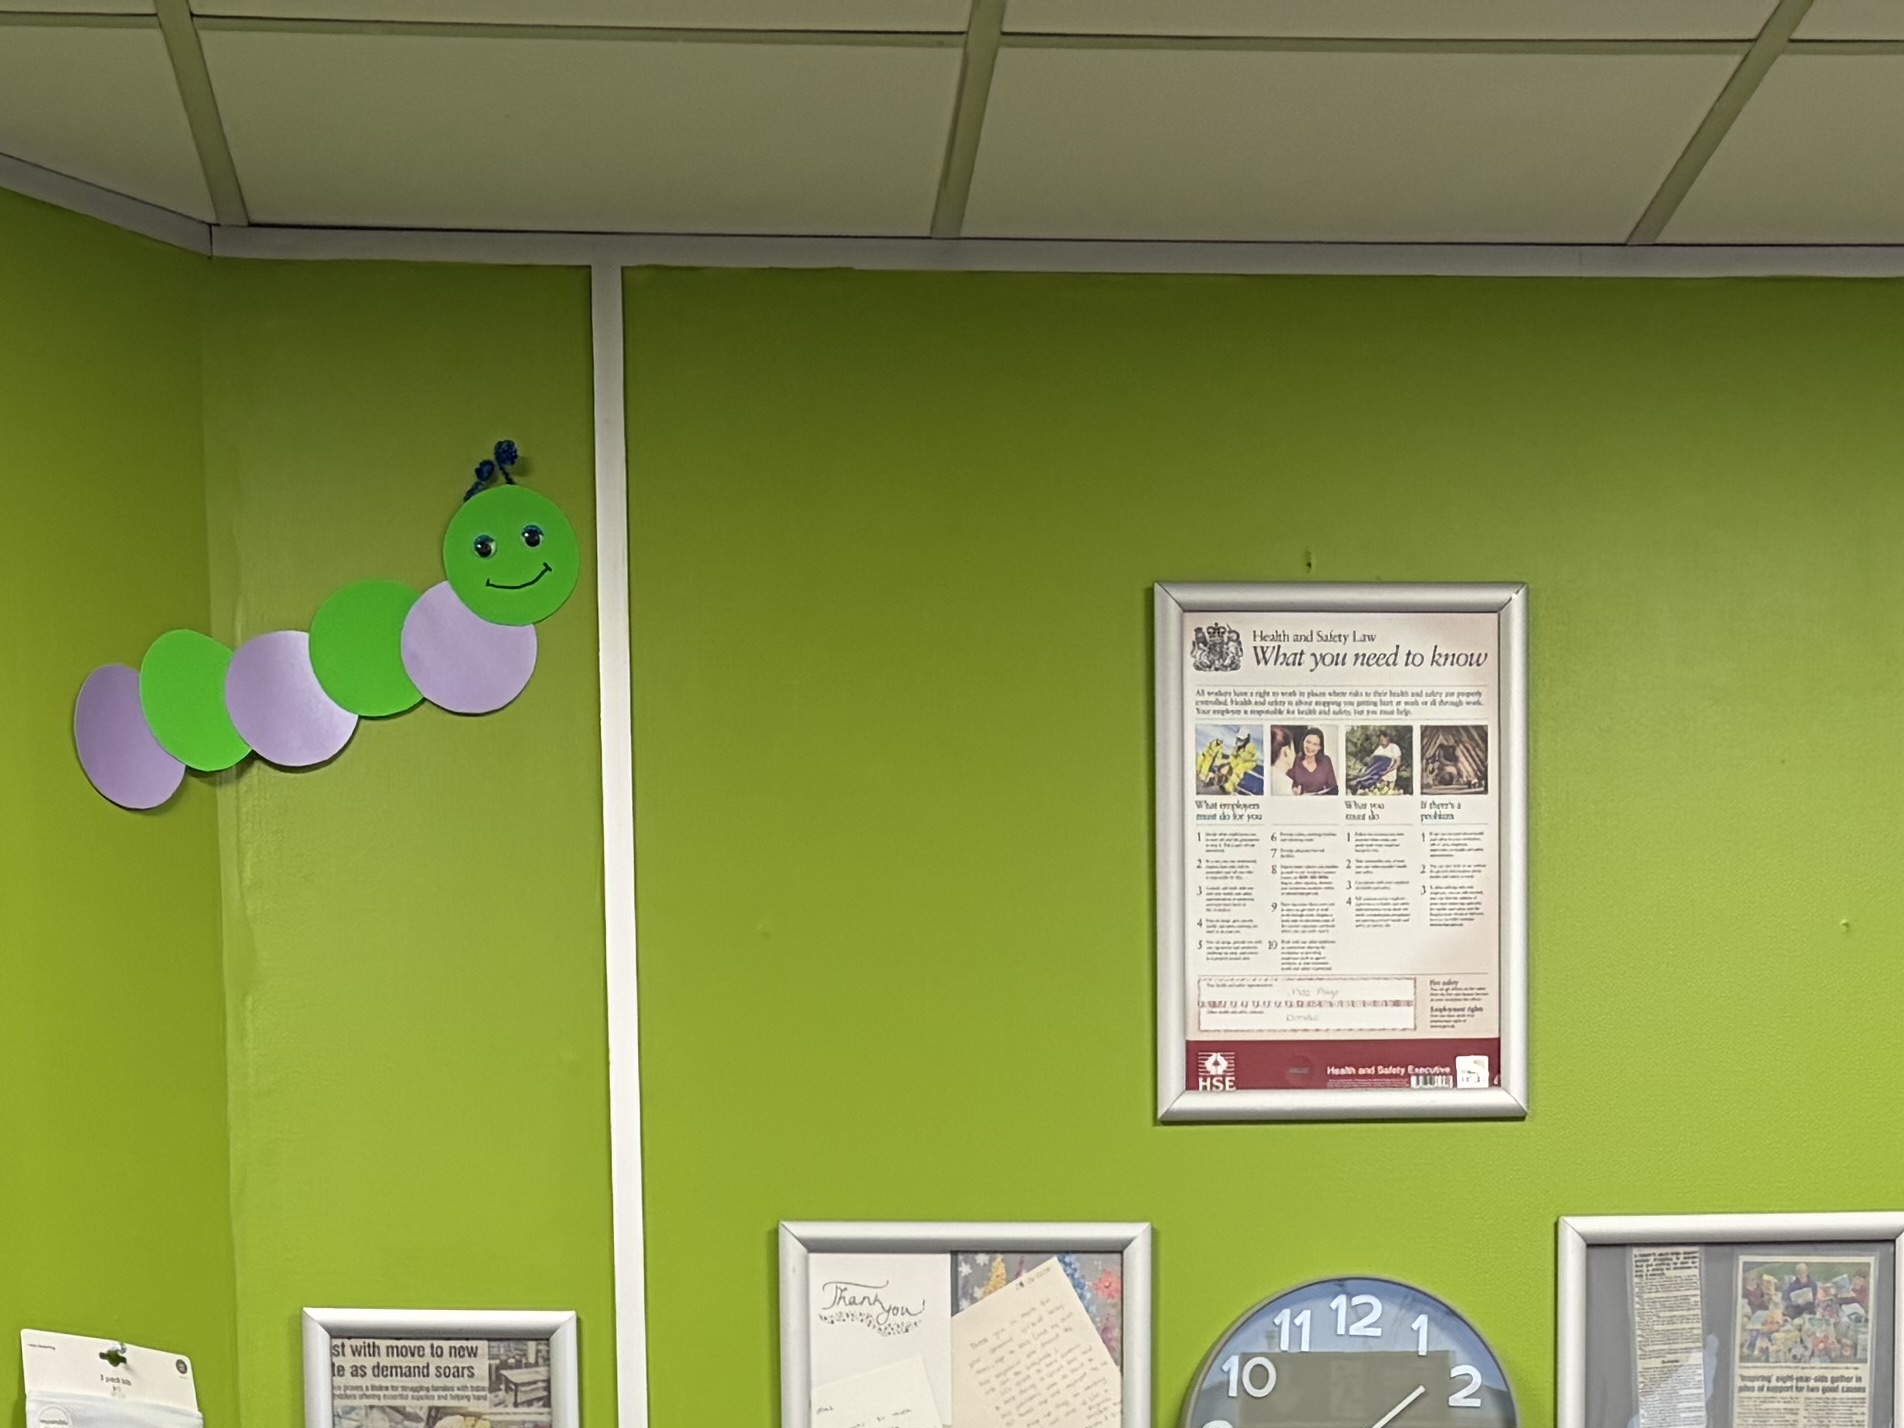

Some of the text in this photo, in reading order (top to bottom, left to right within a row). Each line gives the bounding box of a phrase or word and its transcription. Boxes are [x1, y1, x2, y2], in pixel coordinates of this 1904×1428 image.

[1253, 630, 1376, 646] Health and Safety Law
[1253, 645, 1488, 672] What you need to know
[1198, 1076, 1236, 1091] HSE
[1327, 1065, 1450, 1077] Health and Safety Executive
[1330, 1294, 1382, 1337] 12
[1273, 1308, 1311, 1352] 11
[1411, 1314, 1428, 1356] 1
[350, 1342, 479, 1360] with move to new
[351, 1361, 476, 1379] as demand soars
[1221, 1355, 1277, 1398] 10
[1448, 1365, 1483, 1407] 2
